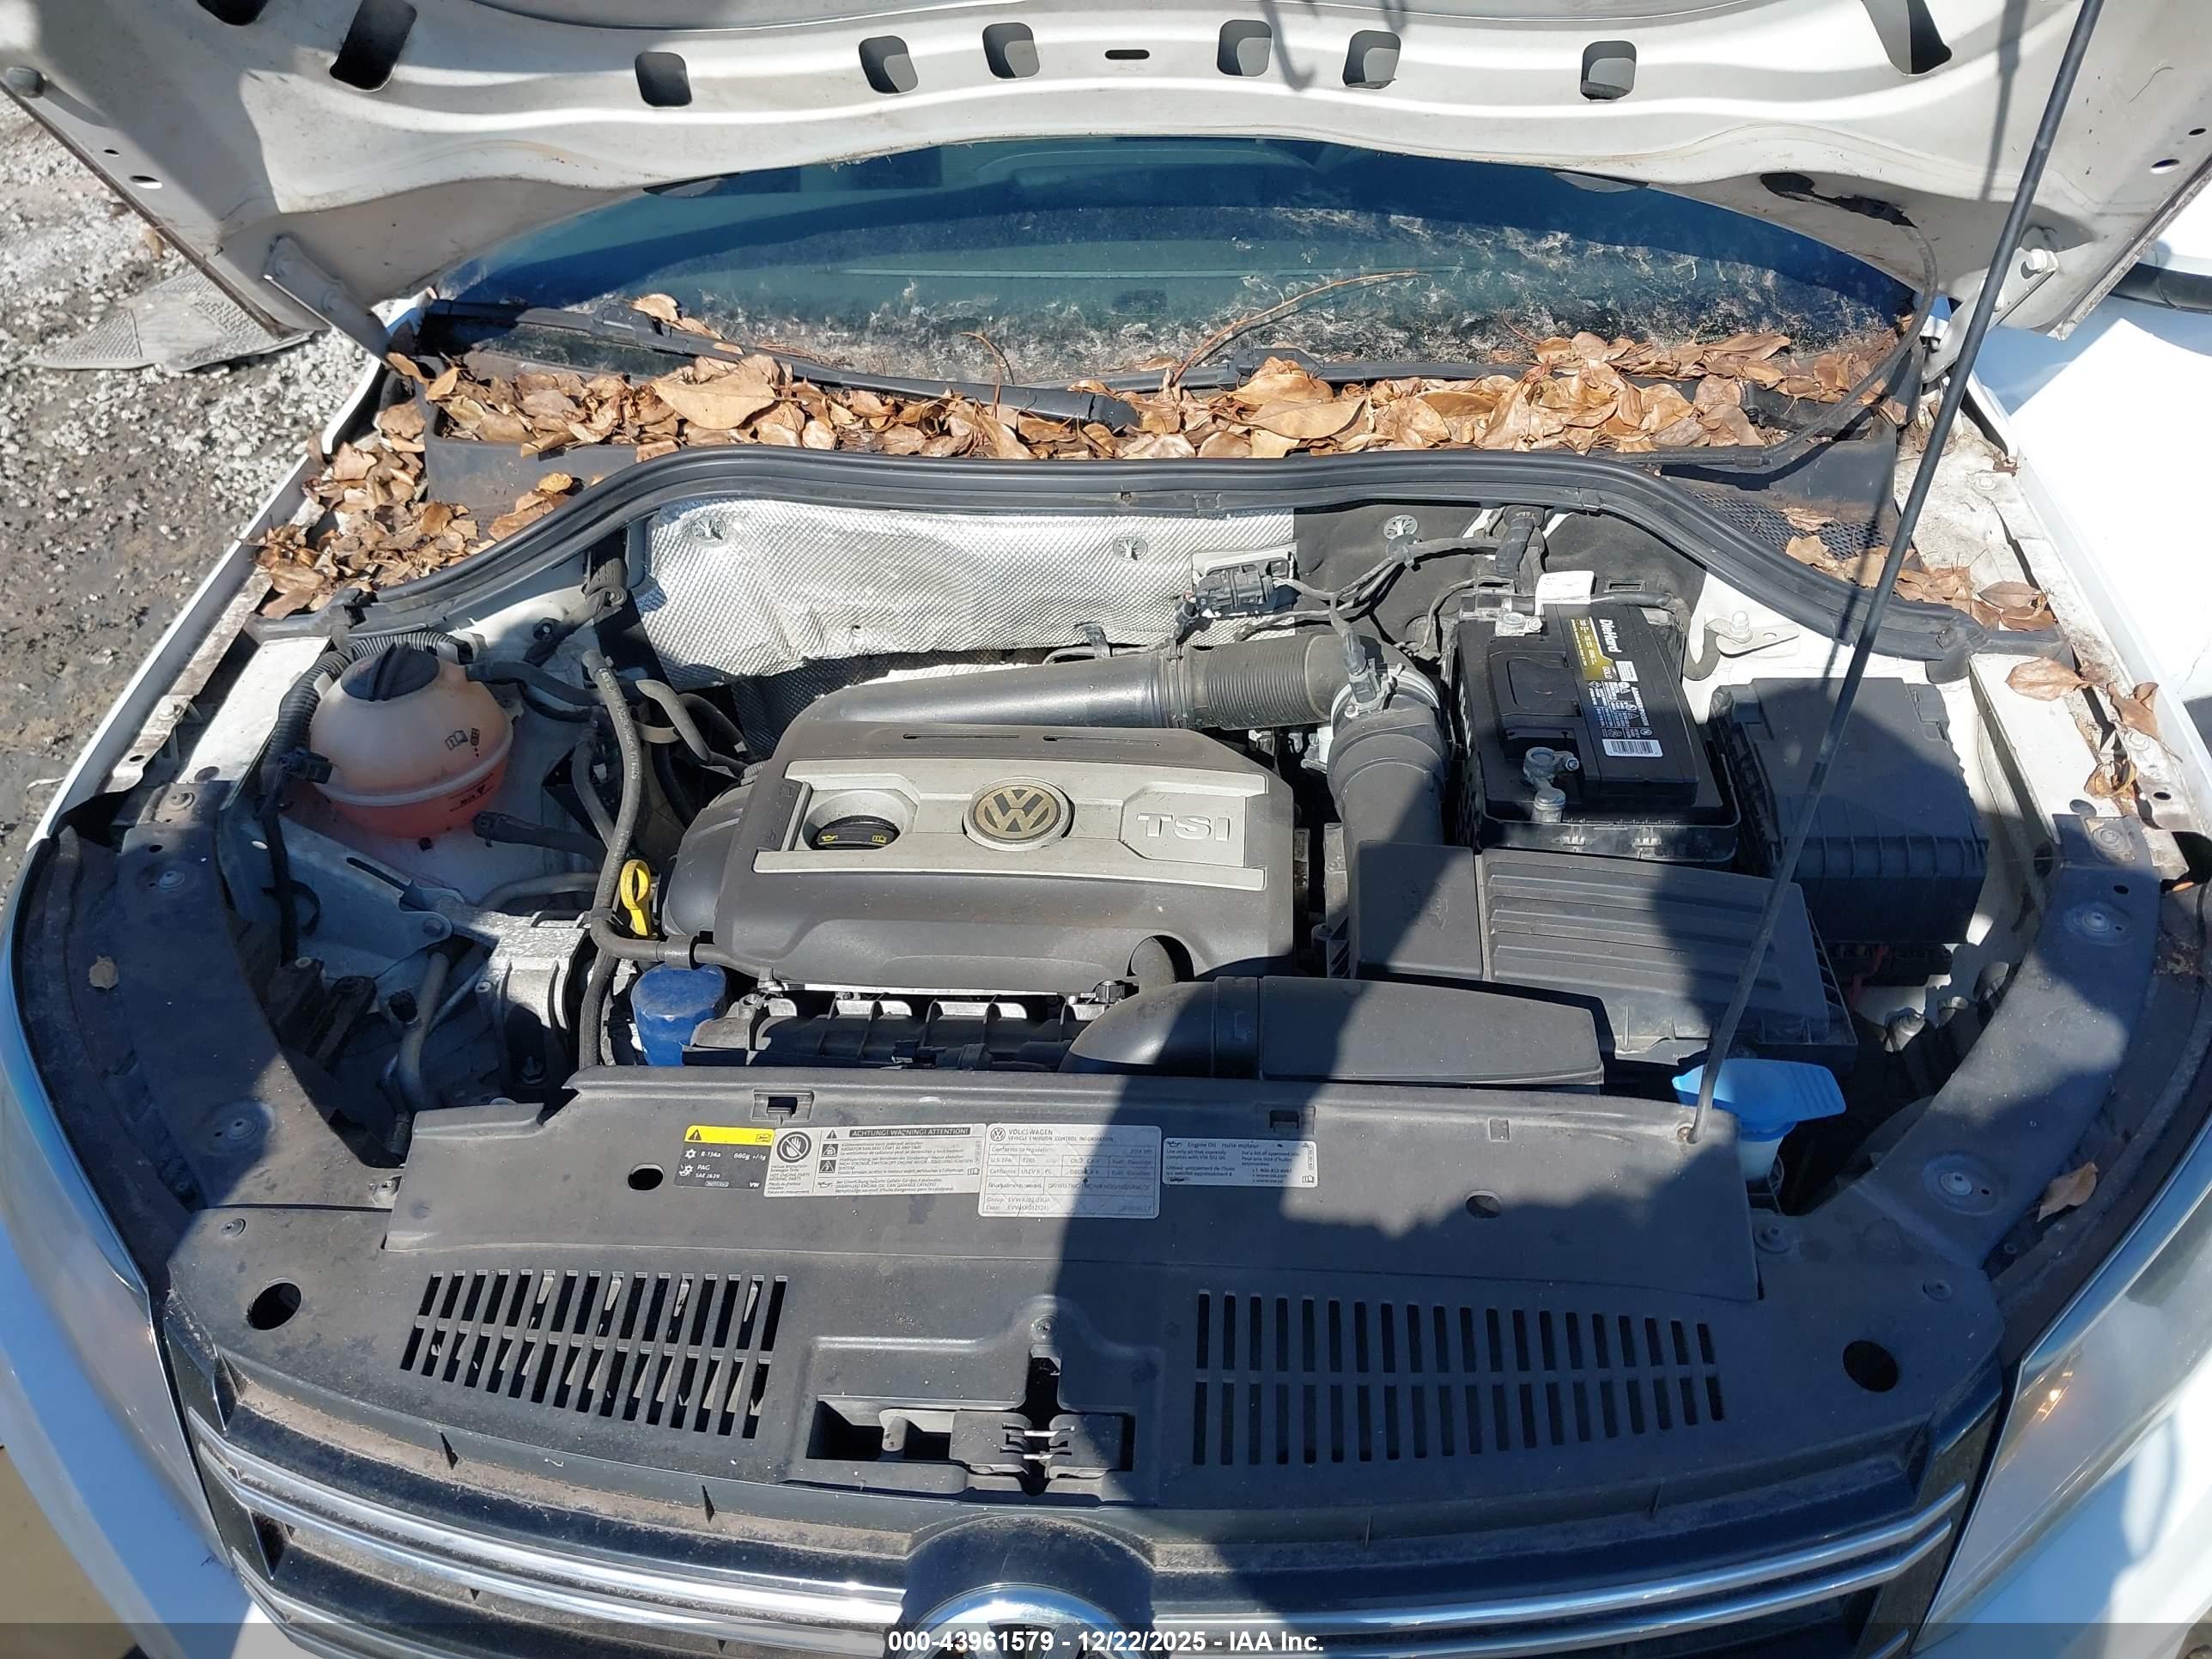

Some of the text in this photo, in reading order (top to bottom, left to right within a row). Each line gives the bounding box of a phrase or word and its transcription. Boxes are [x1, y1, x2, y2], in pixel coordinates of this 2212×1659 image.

[1599, 618, 1622, 653] DieHard
[1601, 665, 1613, 680] GOLD
[1136, 813, 1231, 842] TSI
